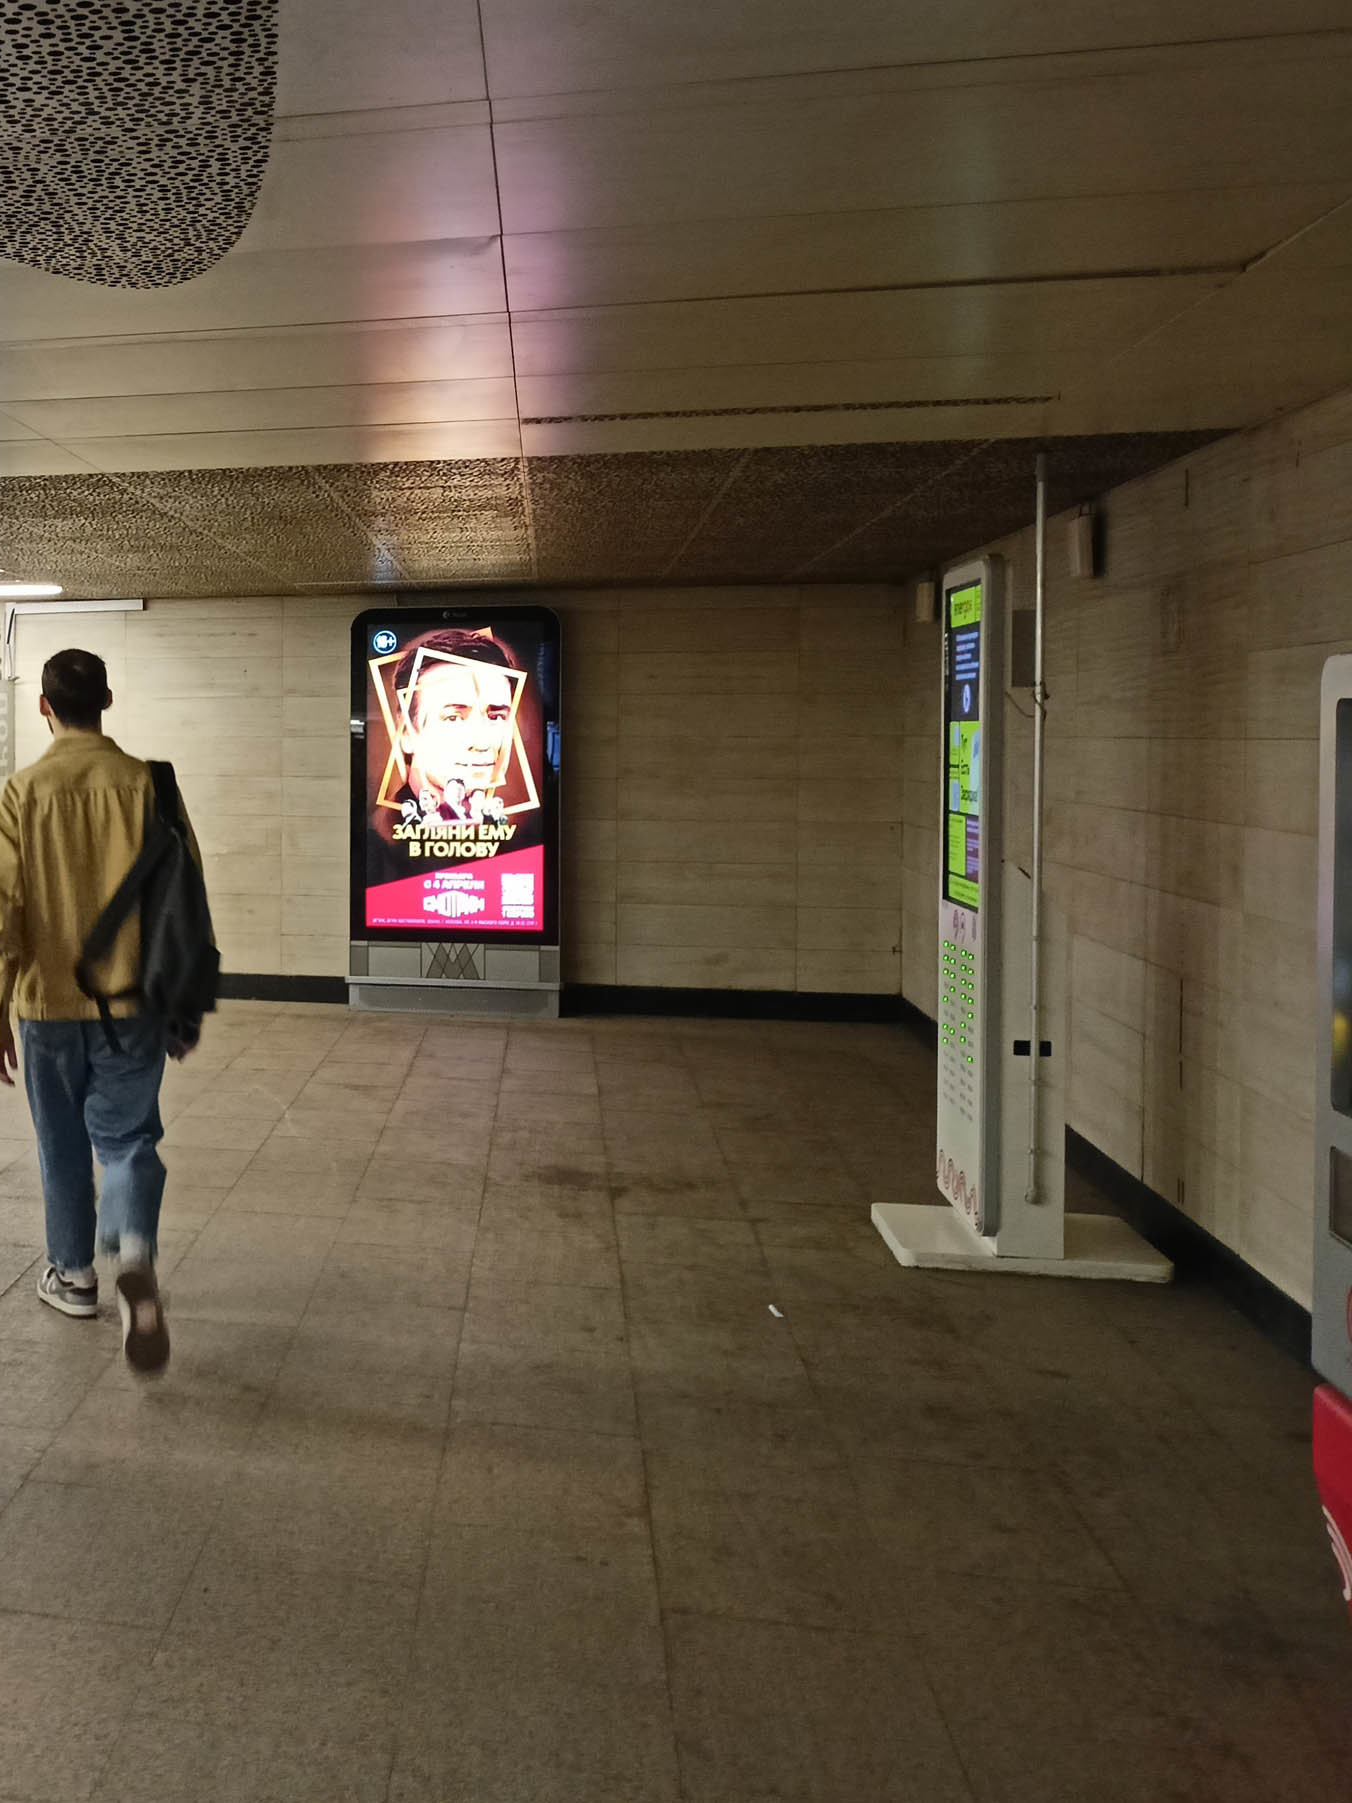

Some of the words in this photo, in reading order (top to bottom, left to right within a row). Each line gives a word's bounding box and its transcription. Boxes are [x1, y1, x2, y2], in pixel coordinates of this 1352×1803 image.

[392, 824, 475, 840] ЗАГЛЯНИ
[478, 824, 517, 840] ЕМУ
[409, 841, 422, 857] В
[424, 841, 500, 858] ГОЛОВУ
[432, 880, 441, 889] 4
[441, 880, 485, 890] АПРЕЛЯ
